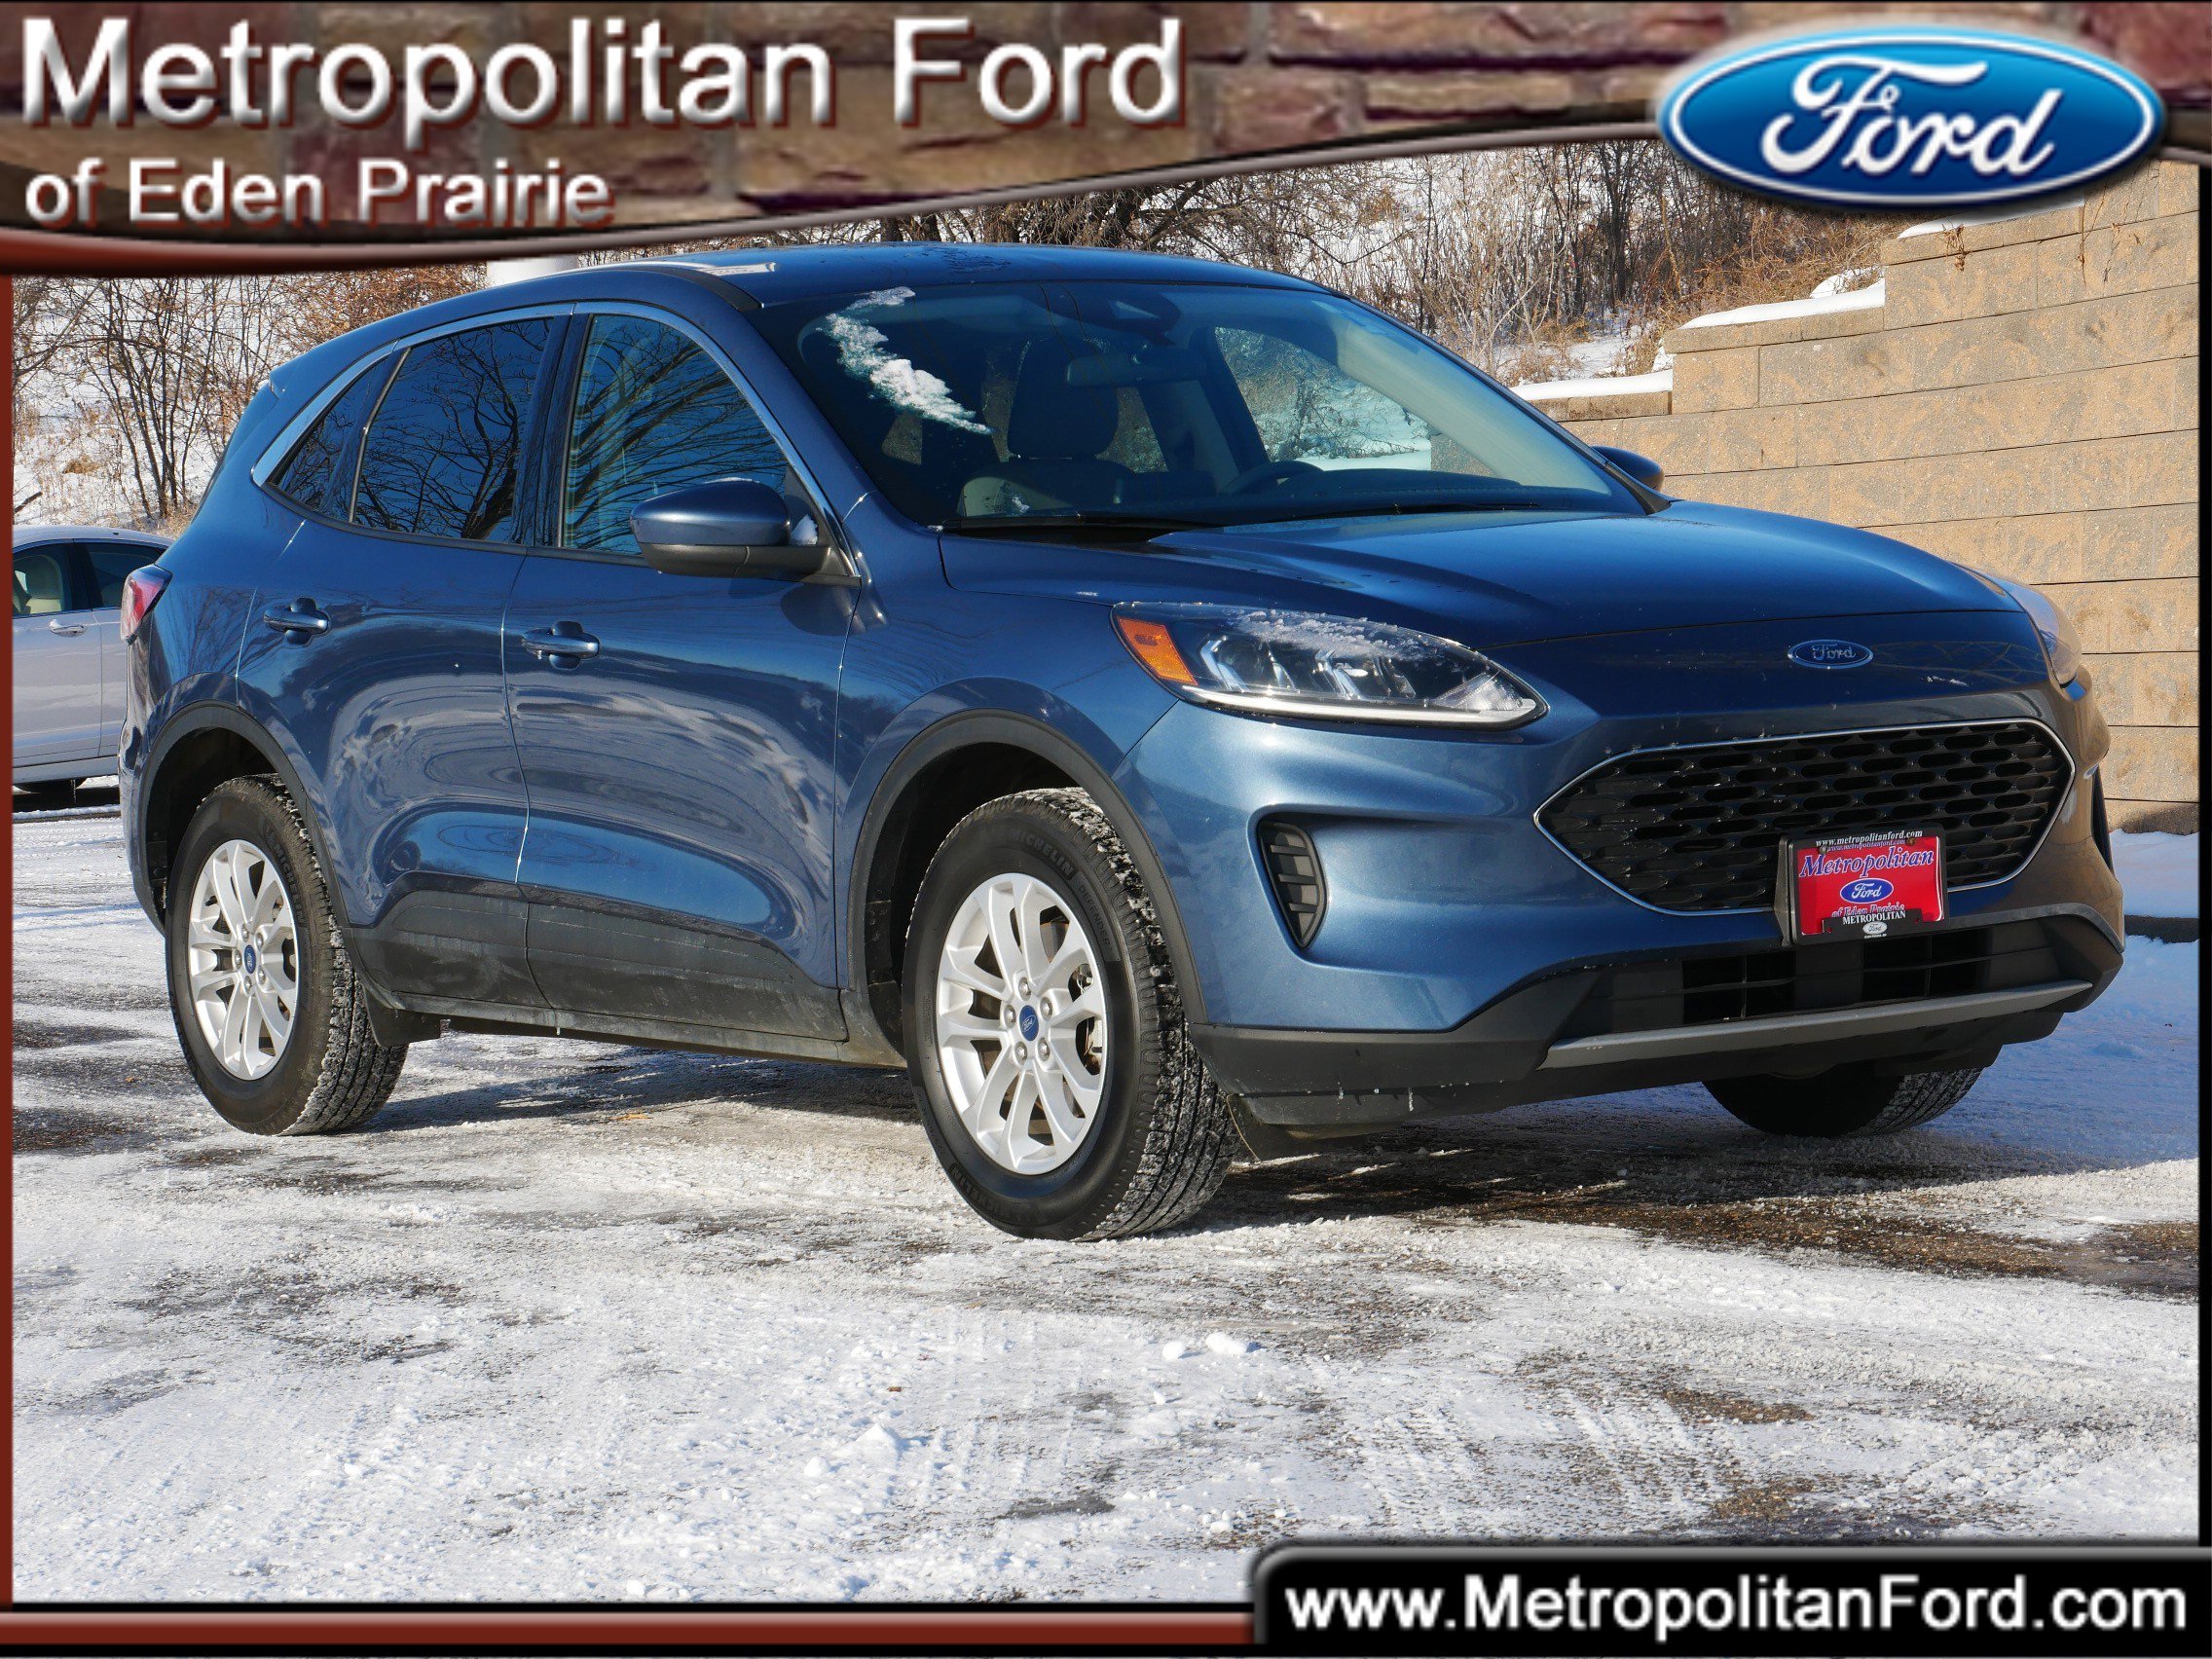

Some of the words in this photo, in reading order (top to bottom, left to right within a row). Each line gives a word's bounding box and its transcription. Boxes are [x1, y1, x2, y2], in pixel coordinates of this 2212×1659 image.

[1811, 644, 1857, 661] Ford
[1815, 830, 1924, 847] www.metropolitanford.com
[1799, 845, 1935, 878] Metropolitan
[1851, 882, 1883, 900] Ford
[1842, 910, 1906, 925] METROPOLITAN
